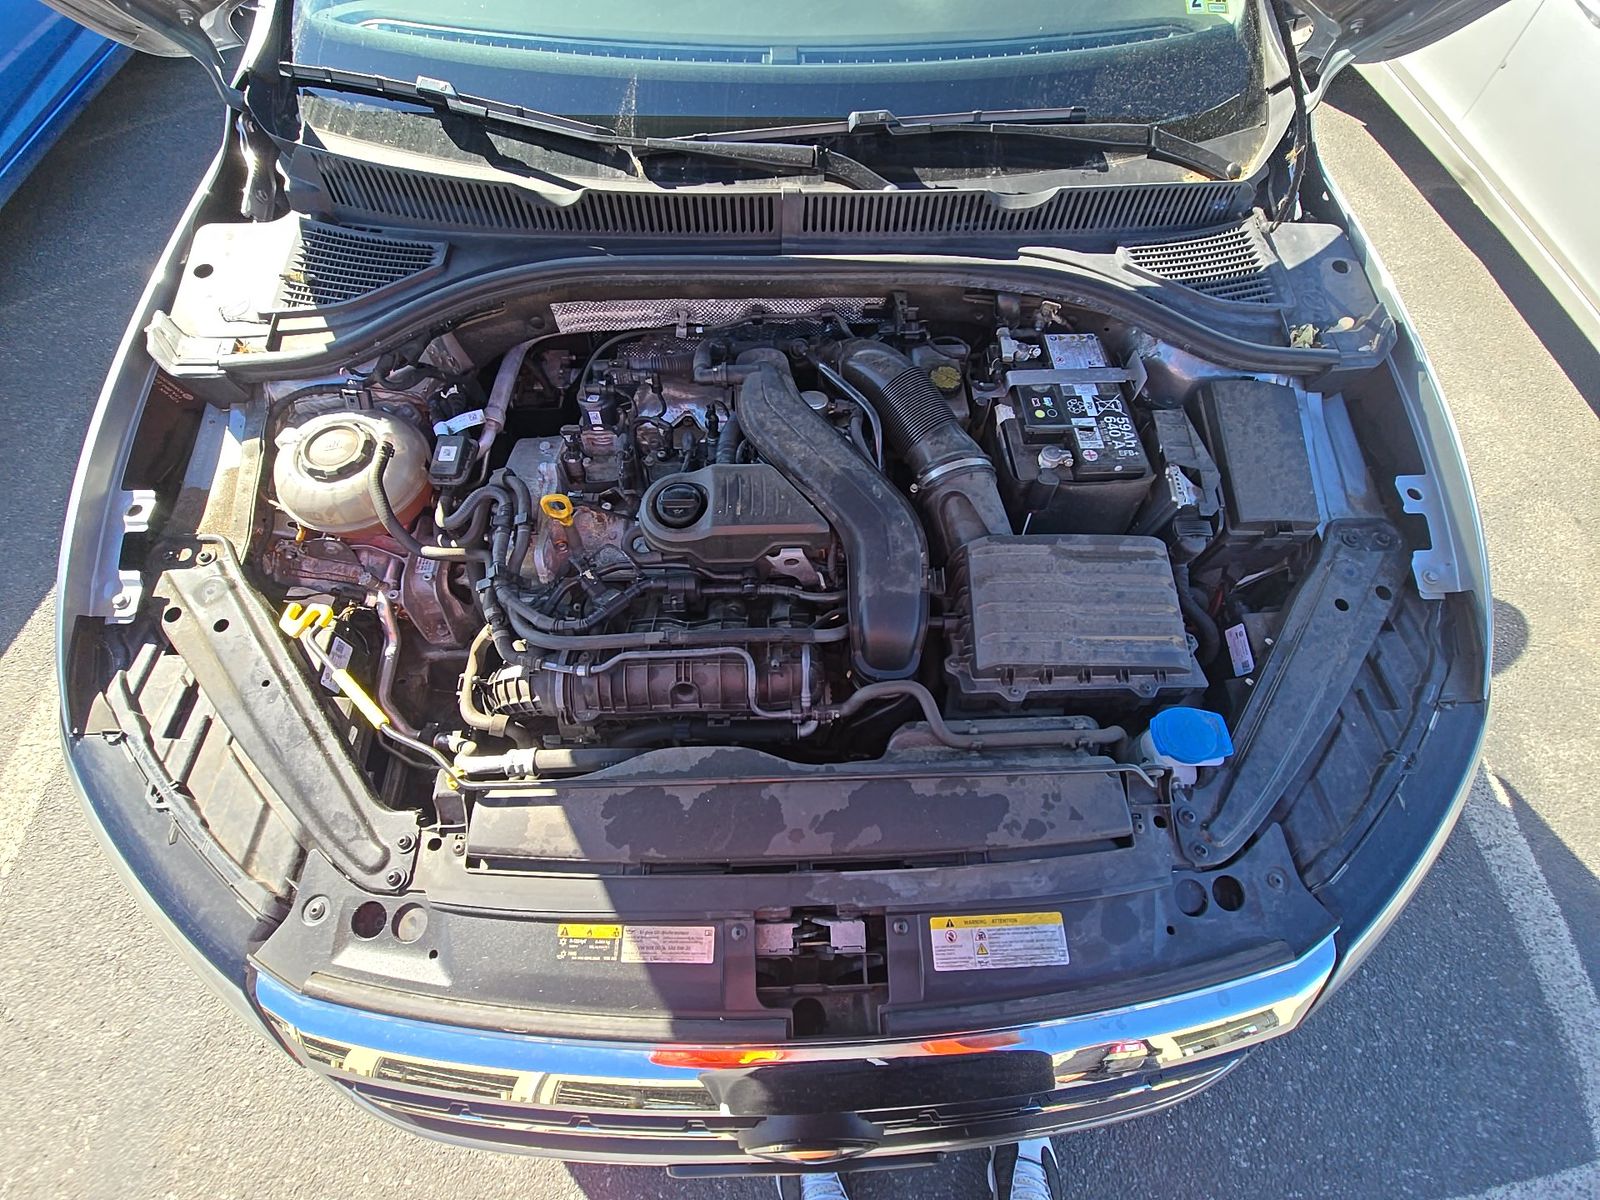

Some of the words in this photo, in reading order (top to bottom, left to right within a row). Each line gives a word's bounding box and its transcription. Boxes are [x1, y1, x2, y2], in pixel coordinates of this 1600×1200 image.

[1104, 416, 1122, 437] 640
[1116, 417, 1137, 447] 59Ah
[1112, 440, 1126, 449] A
